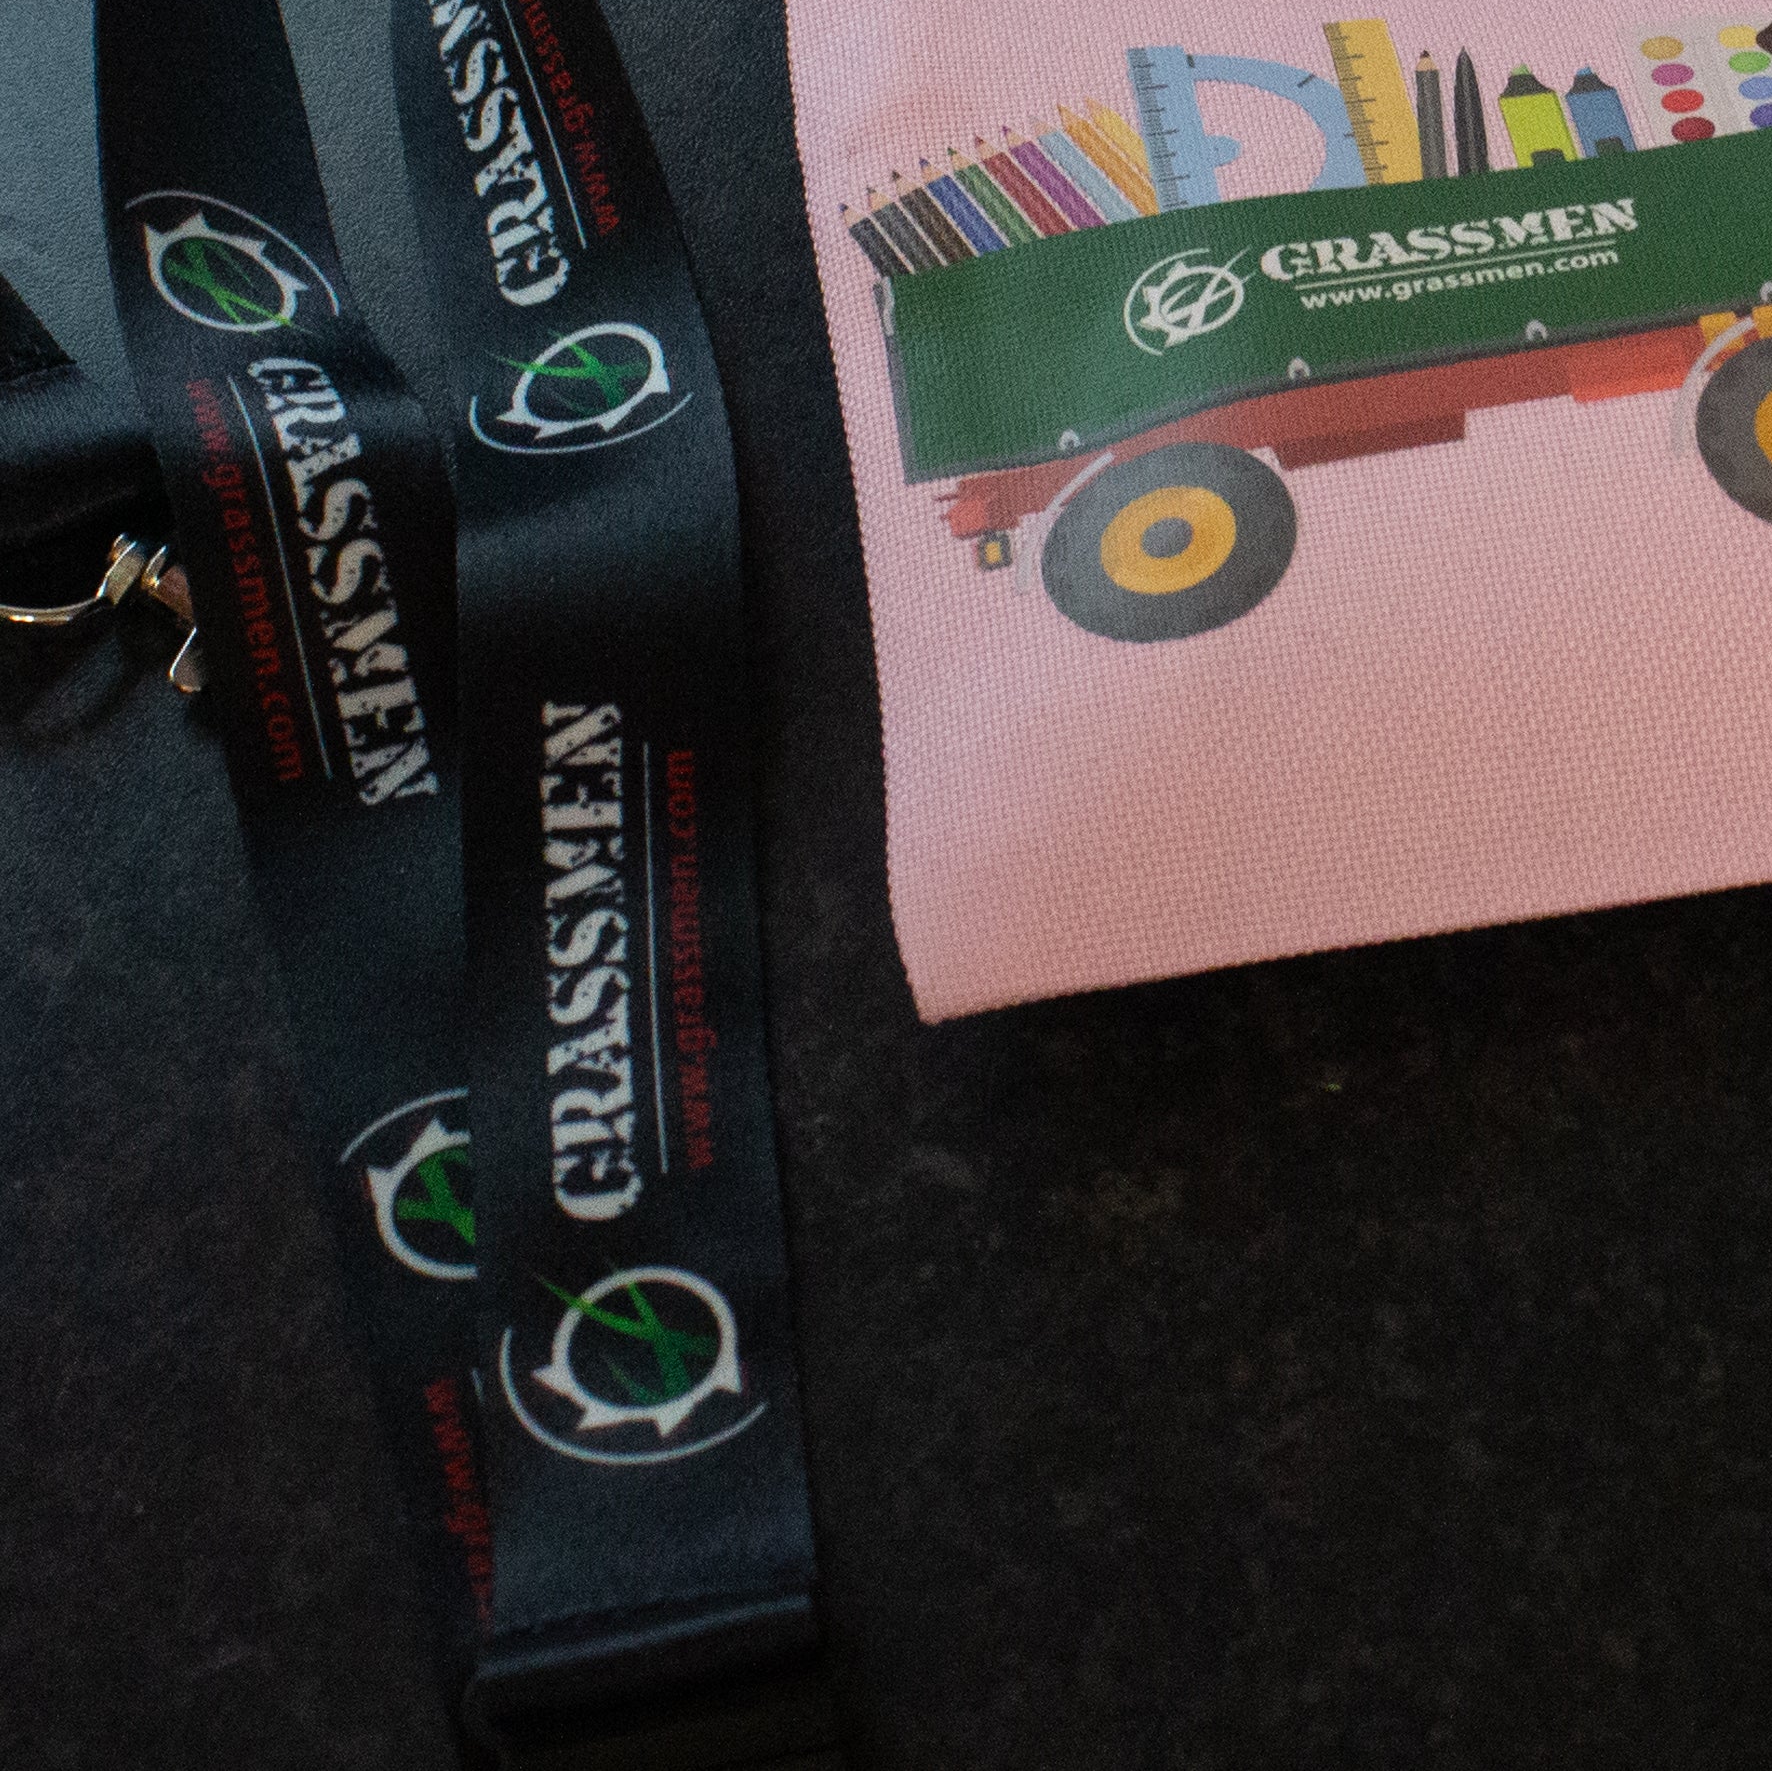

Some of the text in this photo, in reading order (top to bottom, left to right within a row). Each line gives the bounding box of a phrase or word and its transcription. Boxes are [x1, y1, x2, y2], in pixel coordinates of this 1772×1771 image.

[1260, 198, 1640, 282] GRASSMEN
[1300, 248, 1620, 310] www.grassmen.com
[185, 376, 302, 781] www.grassmen.com
[247, 356, 438, 807] GRASSMEN
[540, 699, 643, 1221] GRASSMEN
[665, 748, 718, 1170] www.grassmen.com
